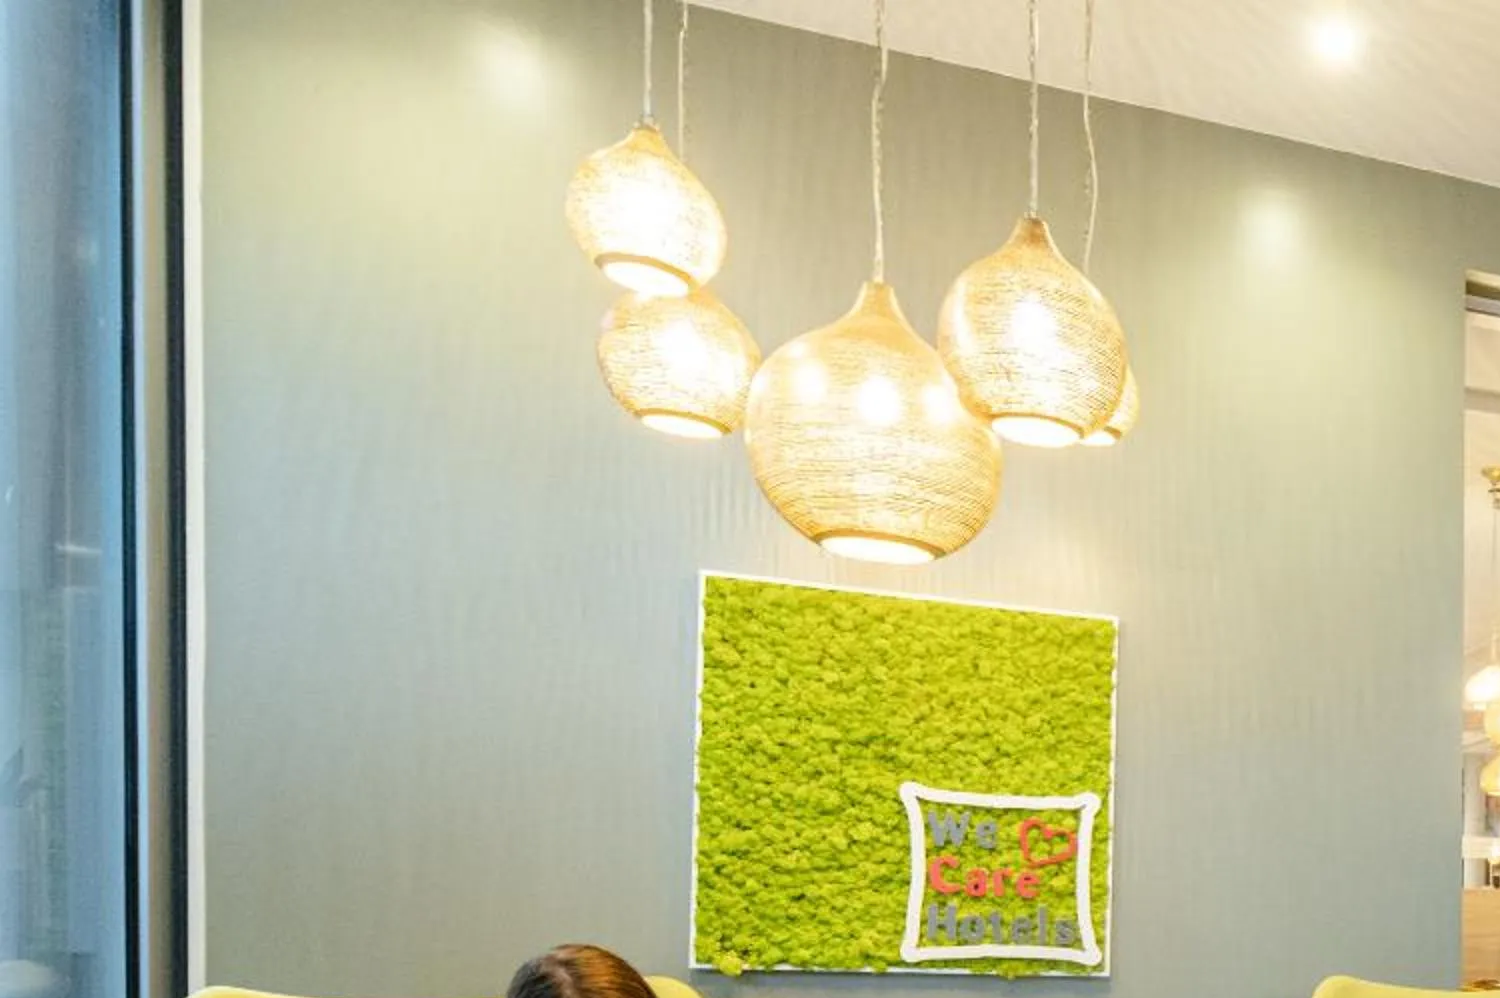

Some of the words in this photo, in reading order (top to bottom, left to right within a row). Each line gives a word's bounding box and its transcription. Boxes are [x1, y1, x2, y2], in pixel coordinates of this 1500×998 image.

[928, 811, 997, 849] We
[929, 855, 1041, 898] Care
[927, 904, 1075, 944] Hotels
